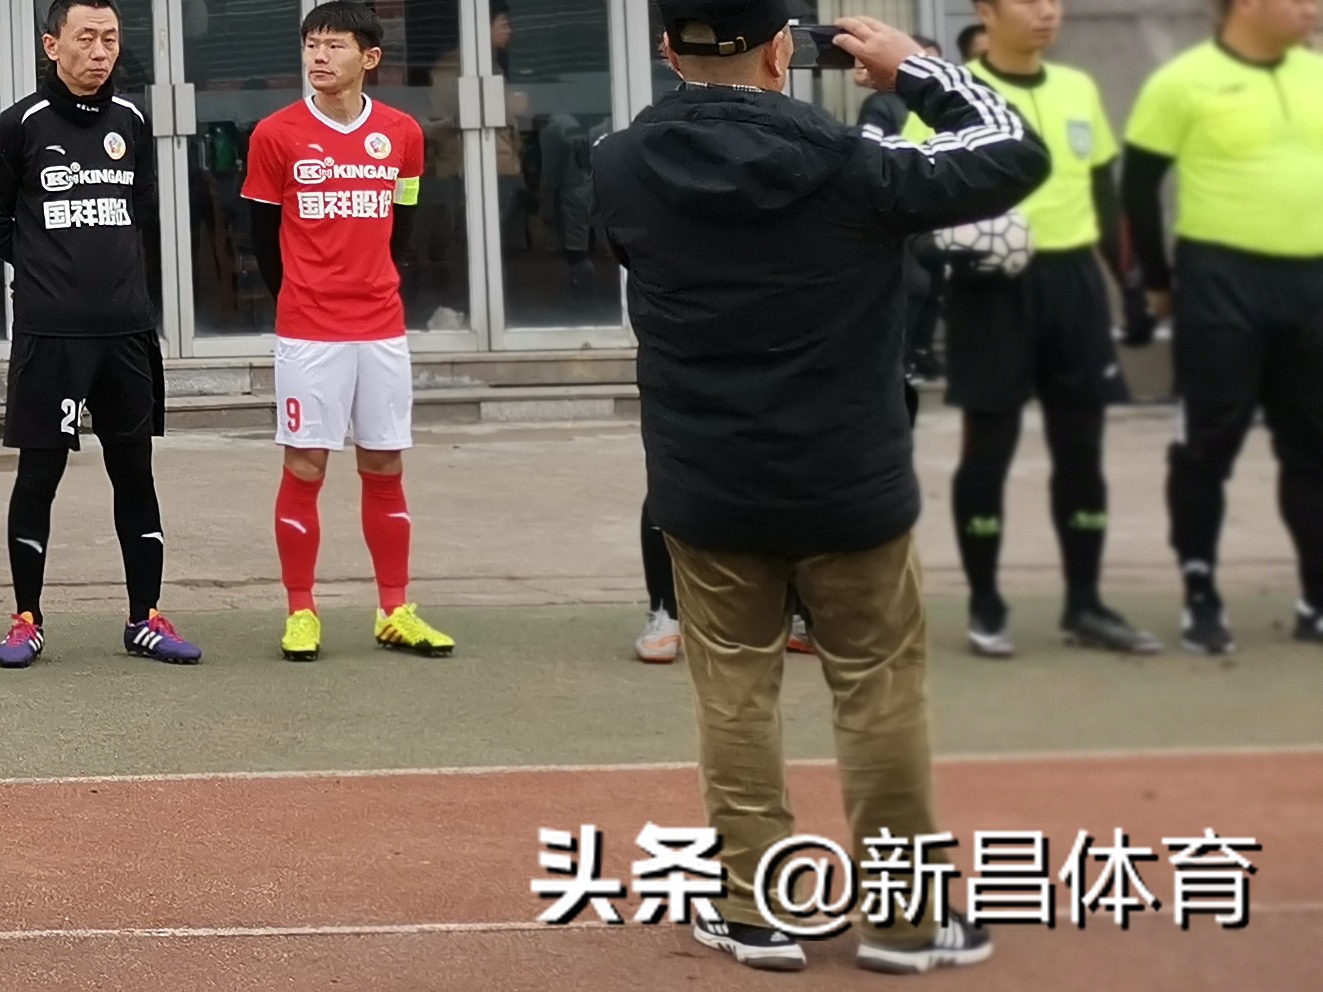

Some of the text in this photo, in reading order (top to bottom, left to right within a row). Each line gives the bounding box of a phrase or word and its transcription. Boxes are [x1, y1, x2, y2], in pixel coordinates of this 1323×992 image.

[79, 168, 135, 185] KINGAIR
[333, 164, 400, 181] KINGAIR
[285, 397, 301, 433] 9
